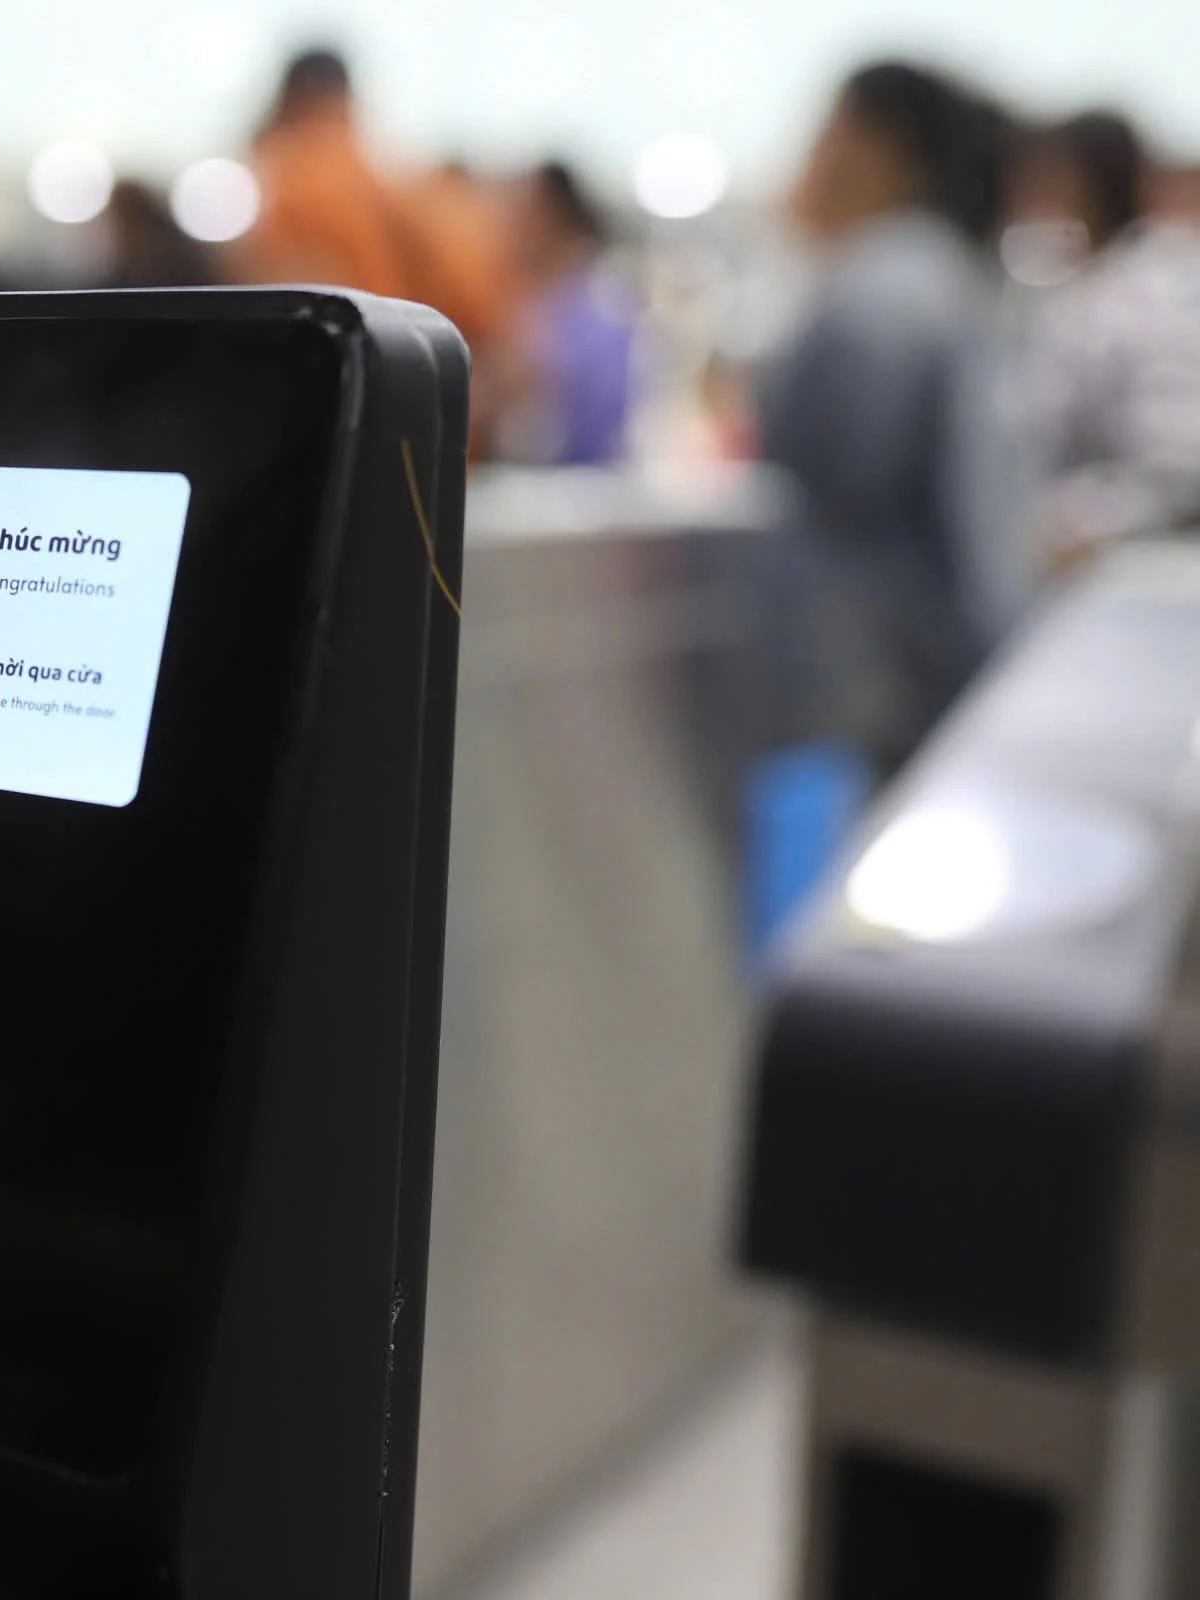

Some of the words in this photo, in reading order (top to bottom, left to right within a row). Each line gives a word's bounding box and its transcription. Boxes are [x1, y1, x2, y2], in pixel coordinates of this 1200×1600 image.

[48, 529, 121, 562] mừng
[28, 664, 62, 683] qua
[67, 664, 103, 685] cửa
[11, 697, 59, 716] through
[62, 701, 82, 716] the
